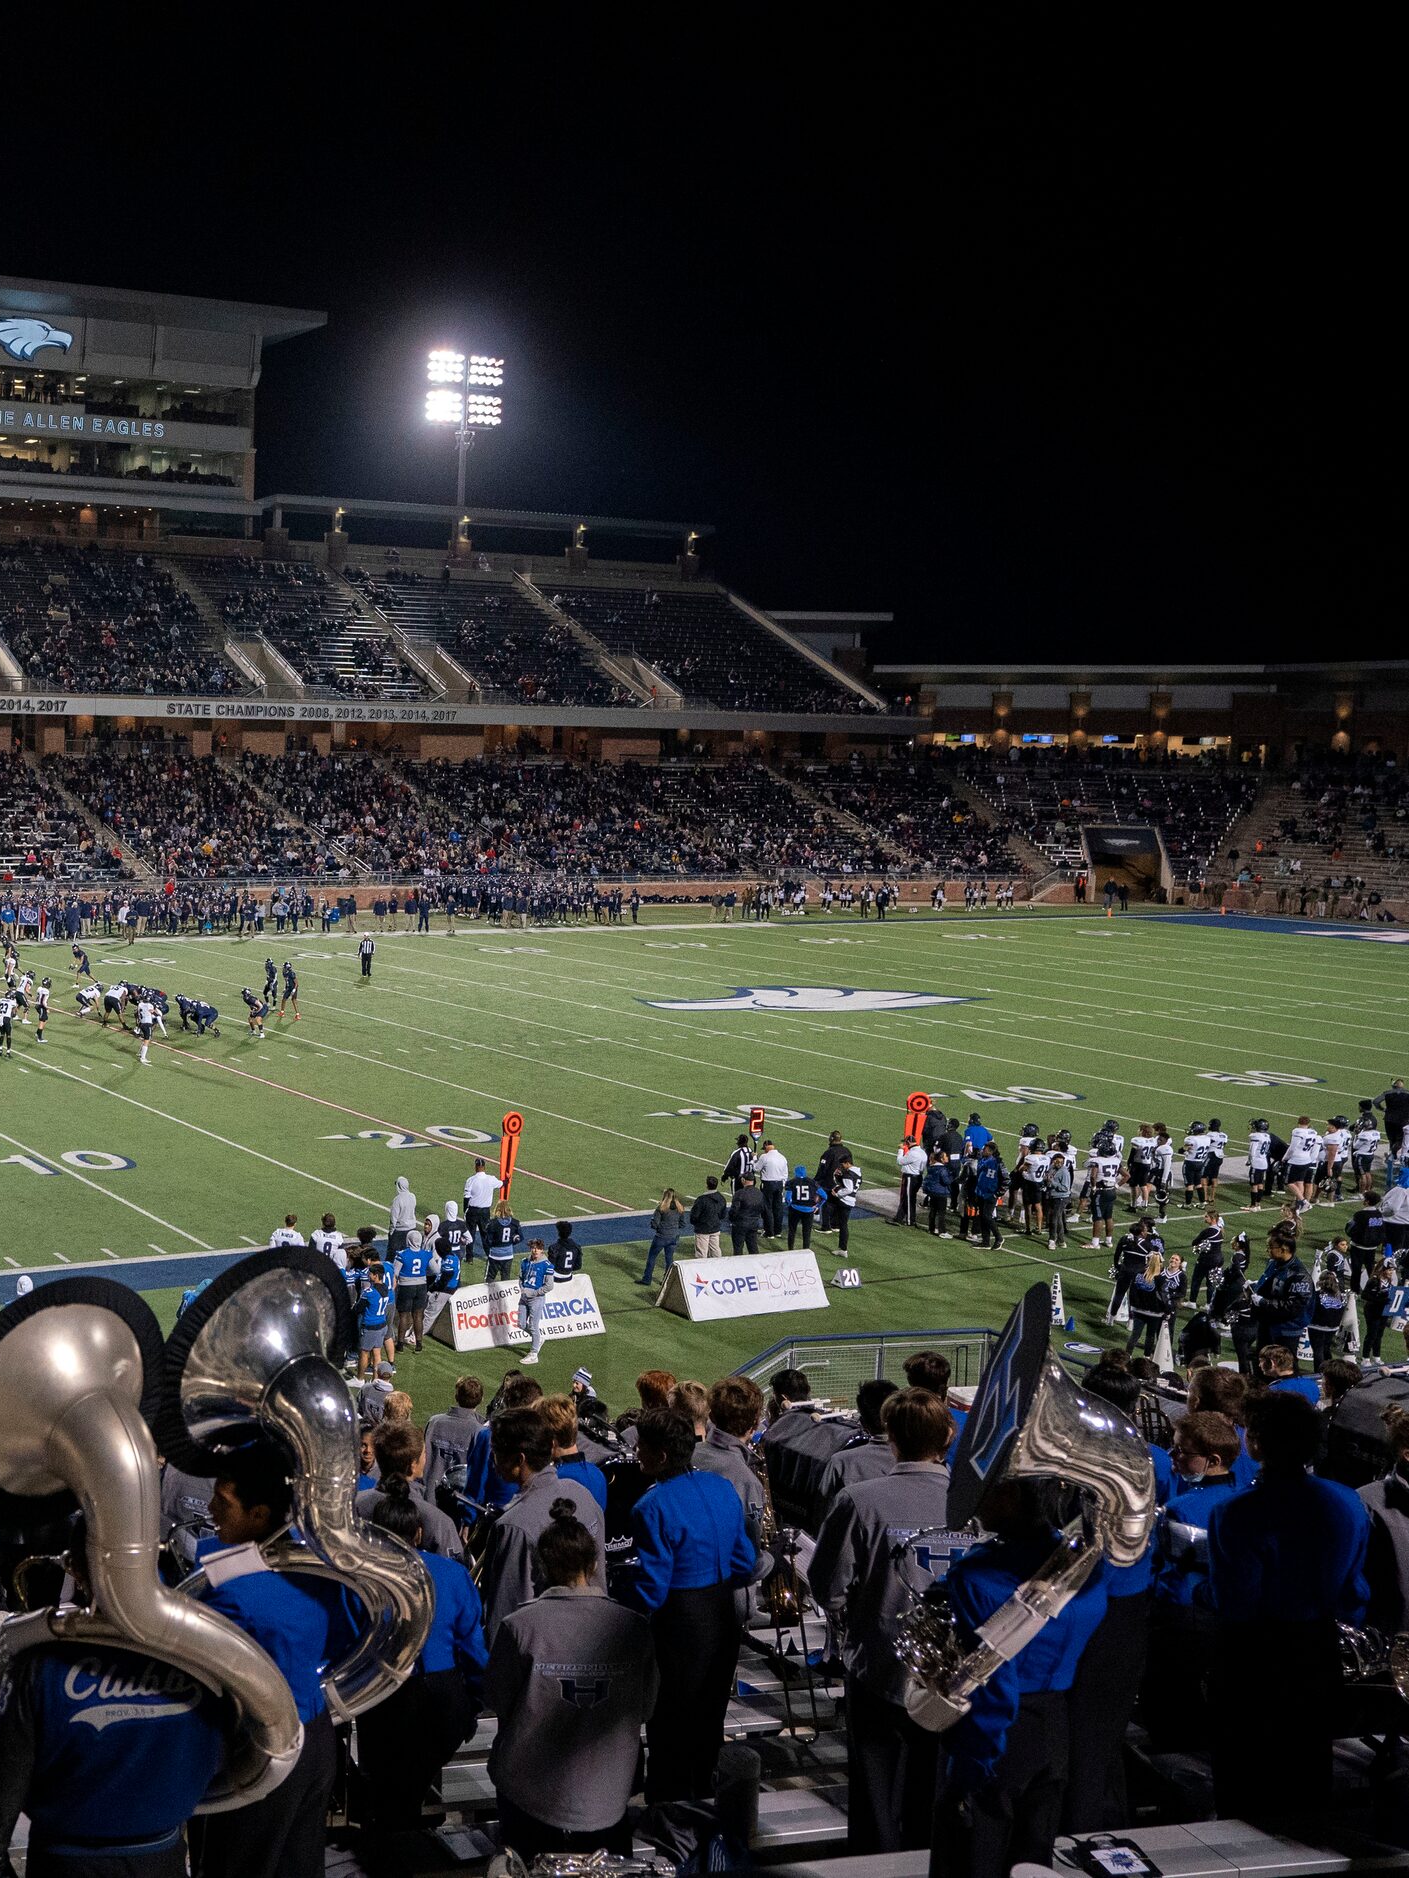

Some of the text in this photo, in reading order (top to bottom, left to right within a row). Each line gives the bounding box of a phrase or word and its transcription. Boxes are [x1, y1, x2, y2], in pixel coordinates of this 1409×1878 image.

[23, 412, 84, 431] ALLEN
[92, 418, 165, 438] EAGLES
[167, 703, 211, 715] STATE
[215, 704, 295, 717] CHAMPIONS
[300, 706, 334, 719] 2008,
[336, 707, 367, 721] 2012,
[401, 709, 430, 722] 2014,
[433, 710, 457, 721] 2017
[1195, 1070, 1328, 1087] 50
[960, 1086, 1086, 1104] 40
[677, 1104, 815, 1124] 30
[751, 1109, 764, 1133] 2
[358, 1126, 501, 1149] 20
[0, 1150, 138, 1176] 10
[795, 1185, 810, 1200] 15
[448, 1230, 462, 1244] 10
[502, 1227, 511, 1243] 8
[411, 1258, 422, 1275] 2
[564, 1252, 574, 1269] 2
[842, 1269, 859, 1287] 20
[376, 1296, 390, 1316] 17
[456, 1285, 520, 1311] RODENBAUGH'S
[457, 1310, 521, 1330] Flooring
[508, 1320, 599, 1340] KITCN BED & BATH
[606, 1540, 632, 1551] REMO
